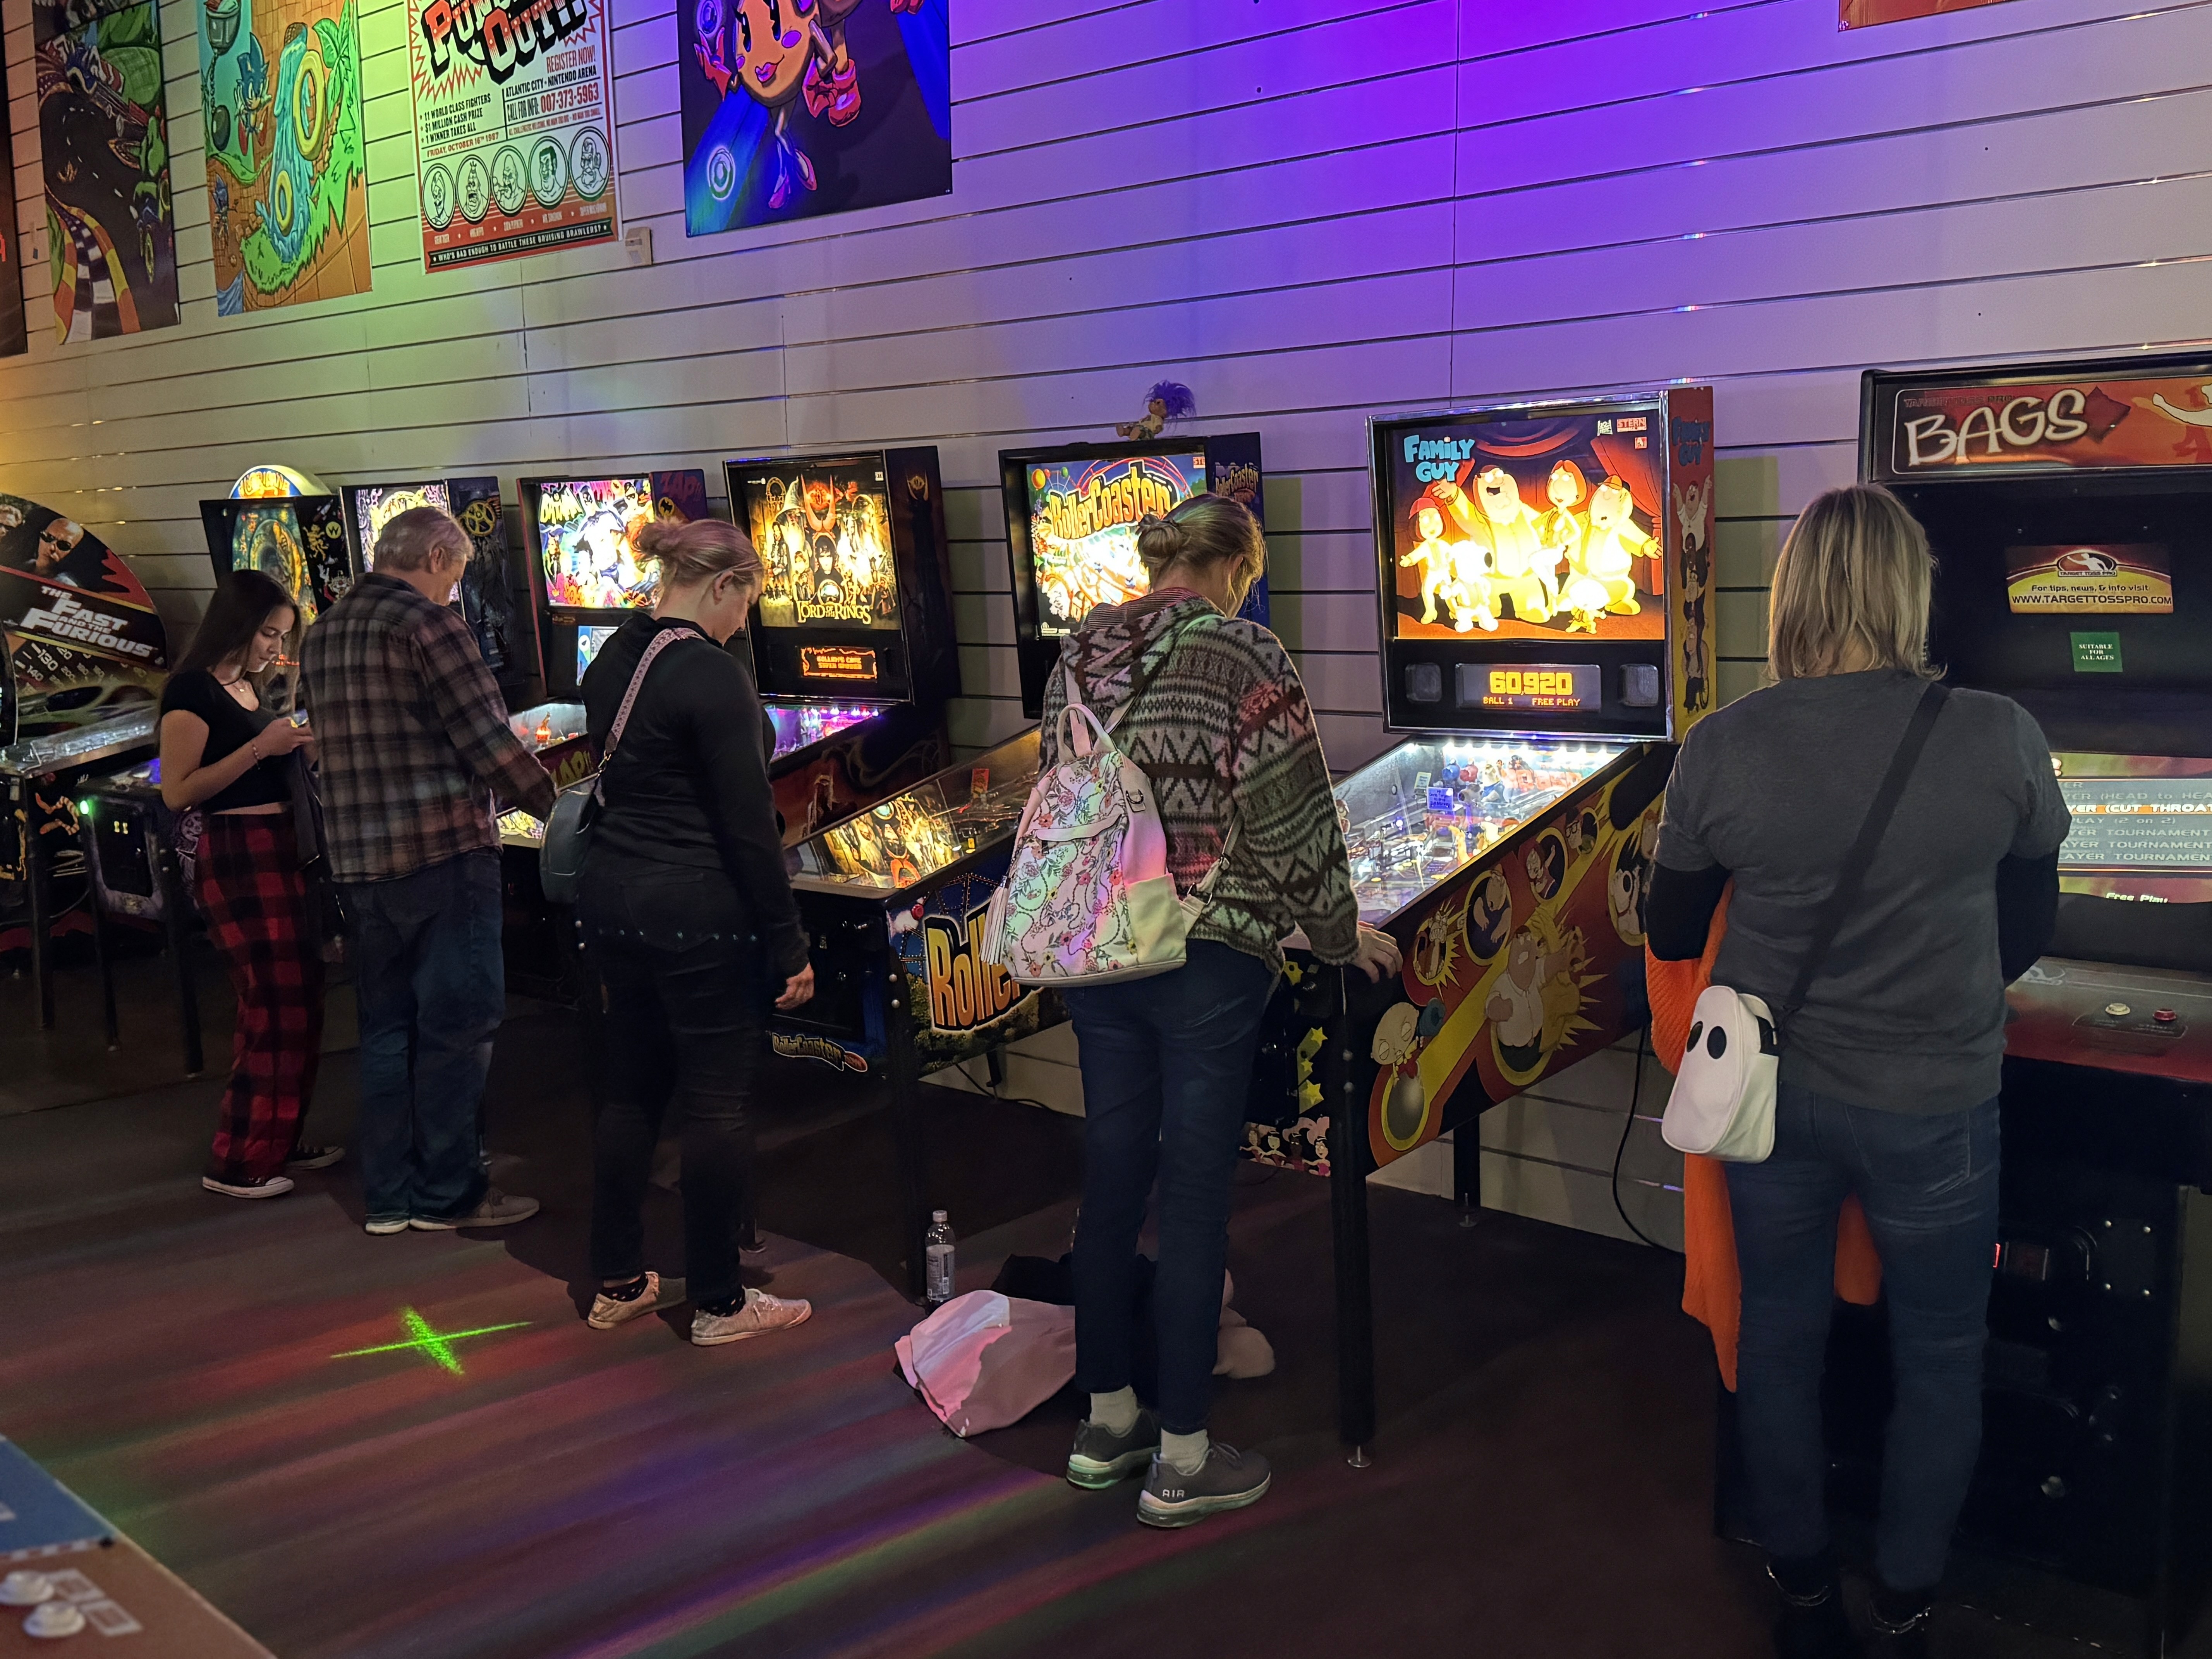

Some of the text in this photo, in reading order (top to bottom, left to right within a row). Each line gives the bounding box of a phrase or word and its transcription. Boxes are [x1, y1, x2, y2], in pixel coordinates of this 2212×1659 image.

[546, 45, 596, 74] REGISTER NOW!
[506, 65, 596, 97] ATLANTIC CITY NINTENDO ARENA
[424, 93, 491, 121] 11 WORLD CLASS FIGHTERS
[425, 107, 483, 134] $1 MILLION CASH PRIZE
[426, 122, 476, 144] 1 WINNER TAKES ALL
[427, 146, 447, 157] FRIDAY,
[448, 139, 474, 152] OCTOBER
[486, 132, 499, 142] 1987
[498, 240, 517, 250] BATTLE
[519, 237, 536, 246] THESE
[566, 225, 601, 238] BRAWLERS?
[1618, 418, 1645, 428] STERN
[1904, 388, 2087, 466] BAGS
[1416, 461, 1459, 482] GUY
[1051, 466, 1171, 539] RollerCoaster
[41, 586, 72, 600] THE
[2013, 595, 2172, 604] WWW.TARGETTOSSPRO.COM
[51, 599, 128, 630] FAST
[797, 601, 826, 623] LORD
[834, 603, 871, 624] RINGS
[20, 608, 155, 657] FURIOUS
[58, 616, 112, 634] AND THE
[38, 649, 58, 671] 130
[27, 665, 43, 681] 140
[1490, 672, 1573, 695] 60,920
[1532, 698, 1554, 706] FREE
[1557, 698, 1580, 706] PLAY
[2105, 804, 2142, 813] (CUT
[2106, 893, 2135, 901] Free
[1163, 1489, 1184, 1498] AIR
